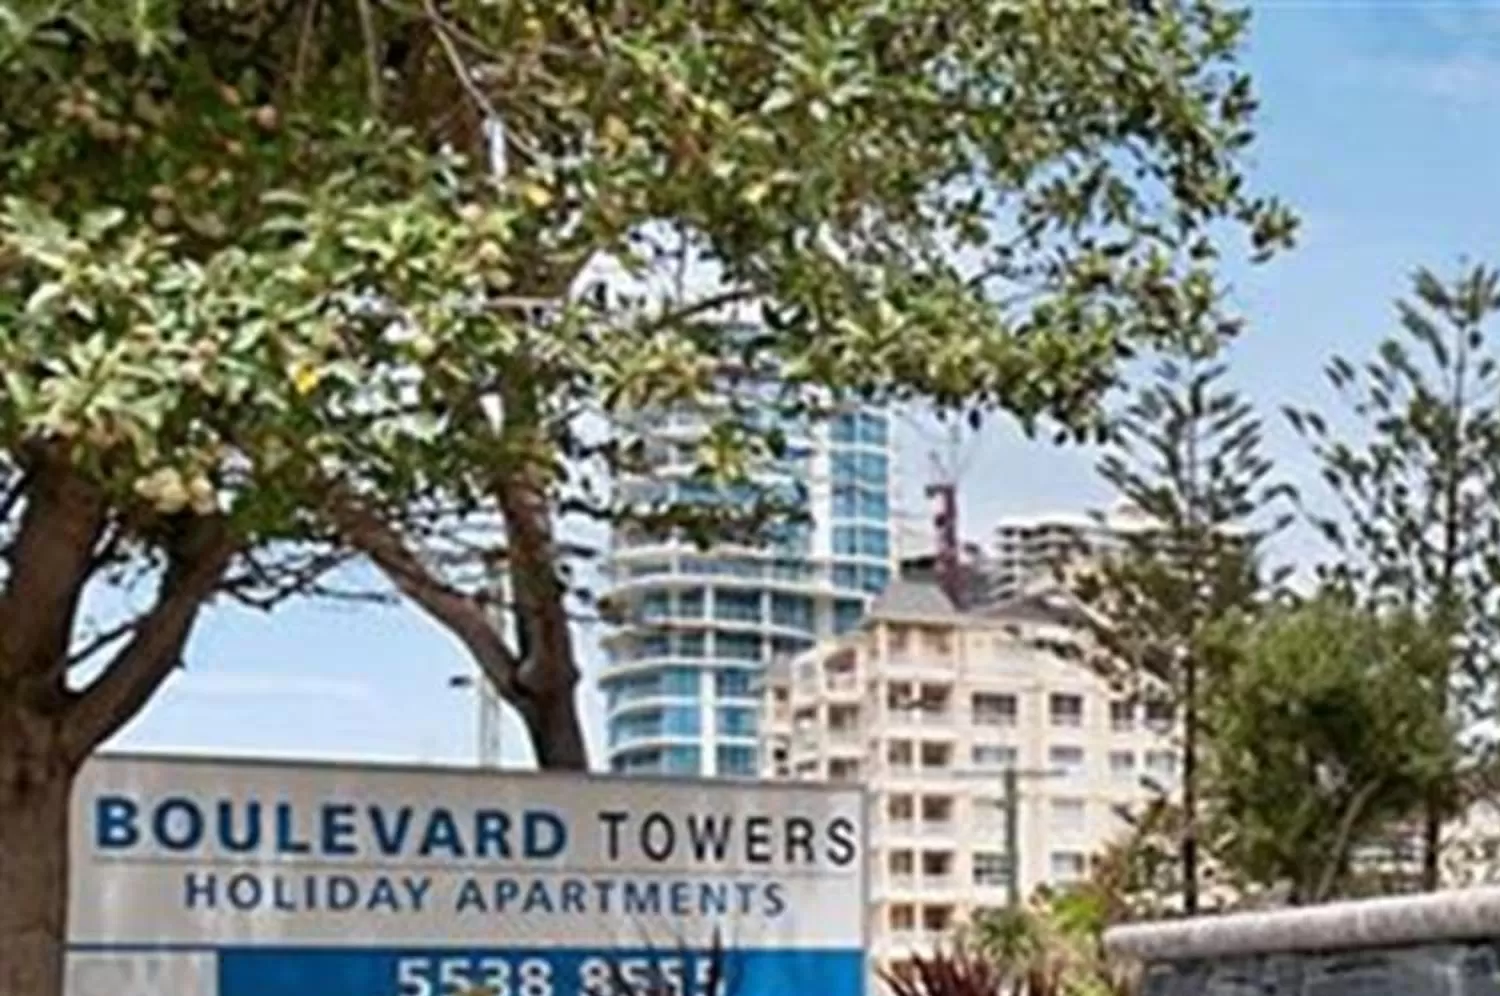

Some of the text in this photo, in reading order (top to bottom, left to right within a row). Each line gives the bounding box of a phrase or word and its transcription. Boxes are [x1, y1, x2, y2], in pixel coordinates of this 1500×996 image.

[97, 797, 857, 866] BOULEVARD TOWERS
[185, 873, 787, 916] HOLIDAY APARTMENTS
